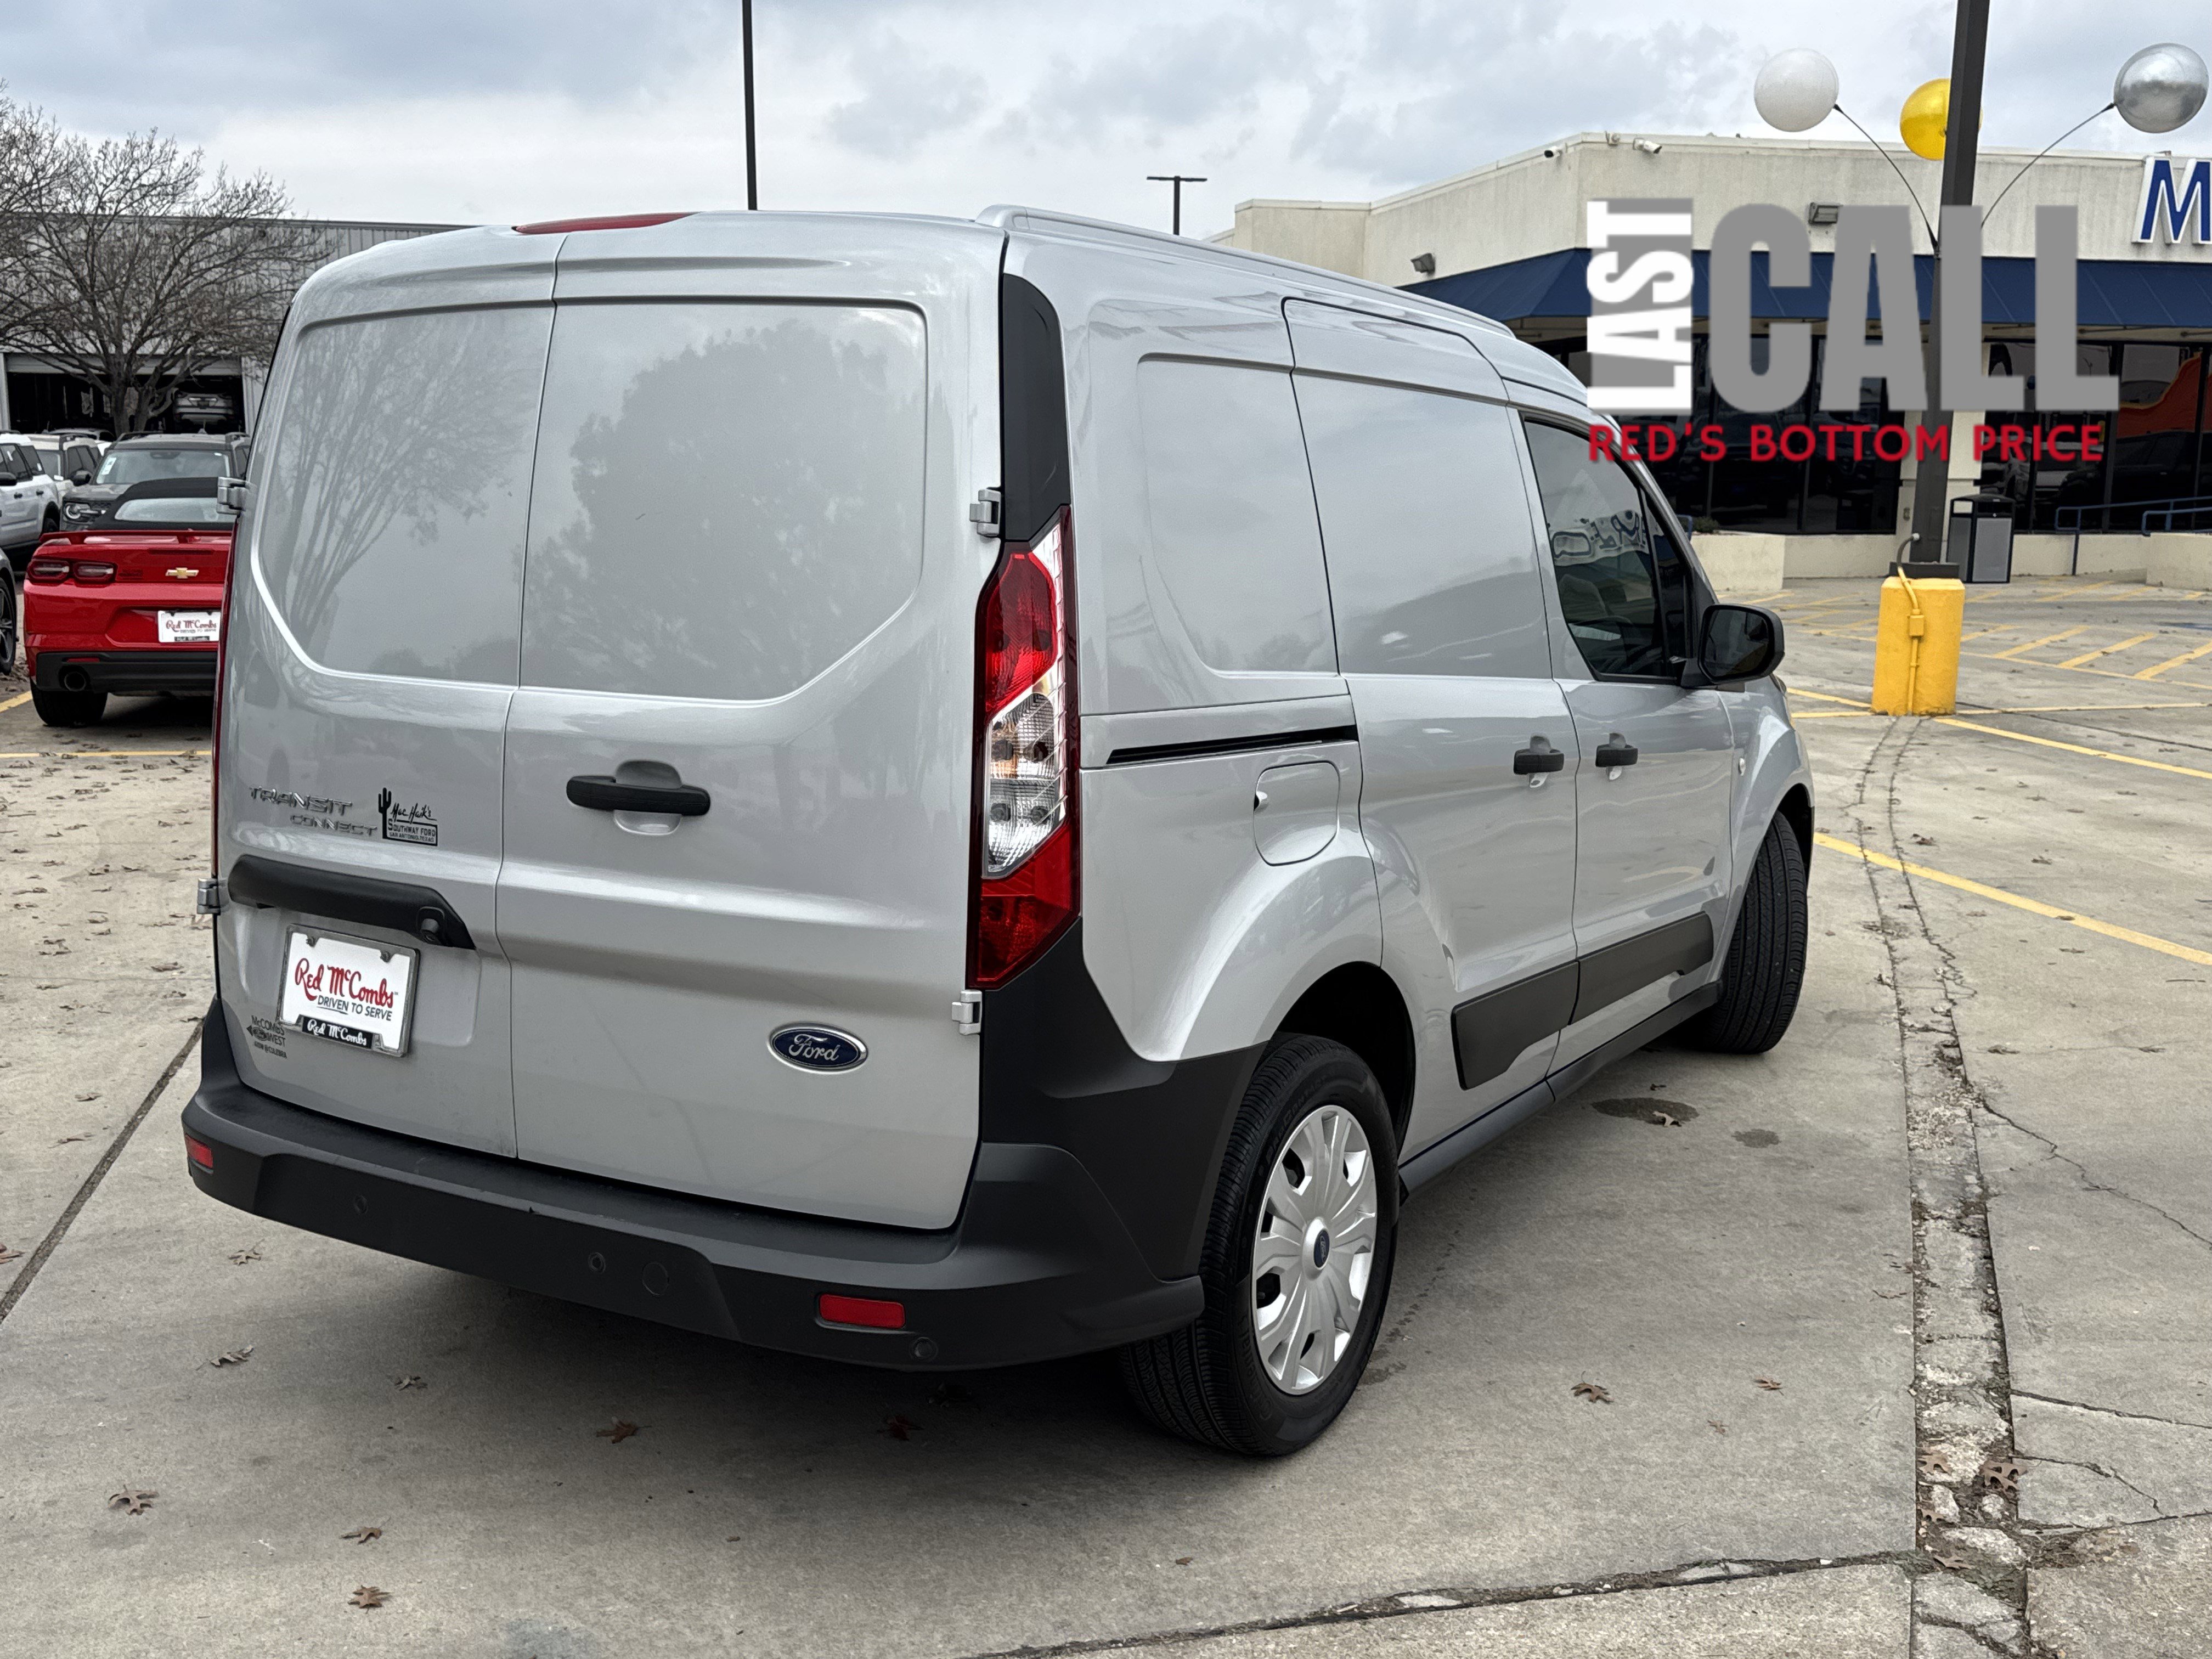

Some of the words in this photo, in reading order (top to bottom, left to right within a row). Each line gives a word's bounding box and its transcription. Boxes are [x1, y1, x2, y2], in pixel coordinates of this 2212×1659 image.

[249, 785, 353, 816] TRANSIT
[290, 815, 377, 836] CONNECT
[420, 827, 436, 837] FORD
[295, 958, 324, 1001] Red
[327, 964, 393, 1008] McCombs
[317, 995, 349, 1012] DRIVEN
[351, 1002, 363, 1015] TO
[364, 1005, 393, 1022] SERVE
[307, 1019, 326, 1036] Red
[328, 1024, 367, 1046] McCombs
[789, 1034, 841, 1062] Ford
